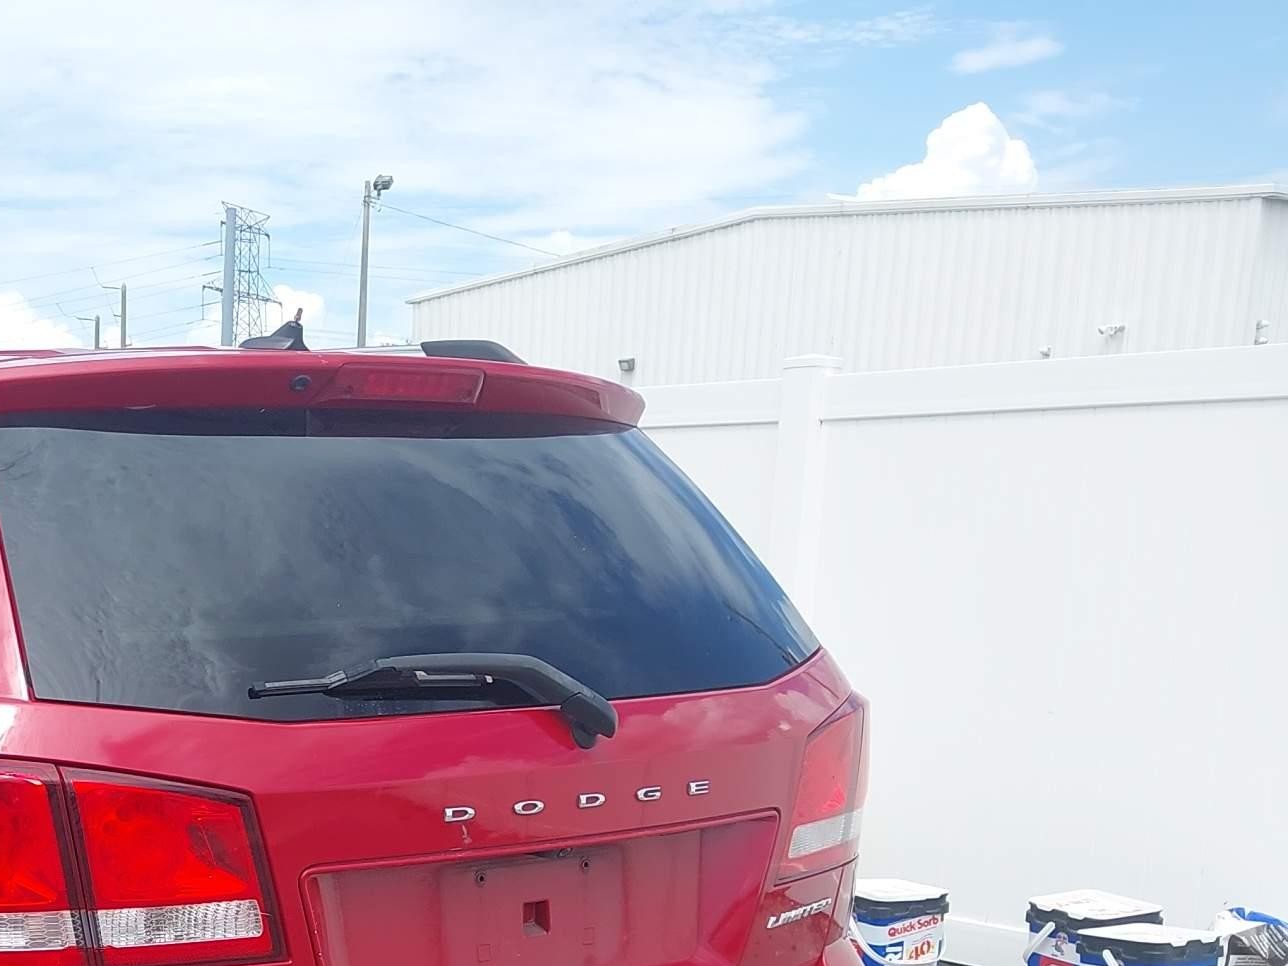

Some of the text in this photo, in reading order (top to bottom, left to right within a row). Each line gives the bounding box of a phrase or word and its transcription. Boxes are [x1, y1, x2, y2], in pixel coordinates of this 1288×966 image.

[444, 780, 710, 823] DODGE
[888, 915, 940, 938] Quick Sorb
